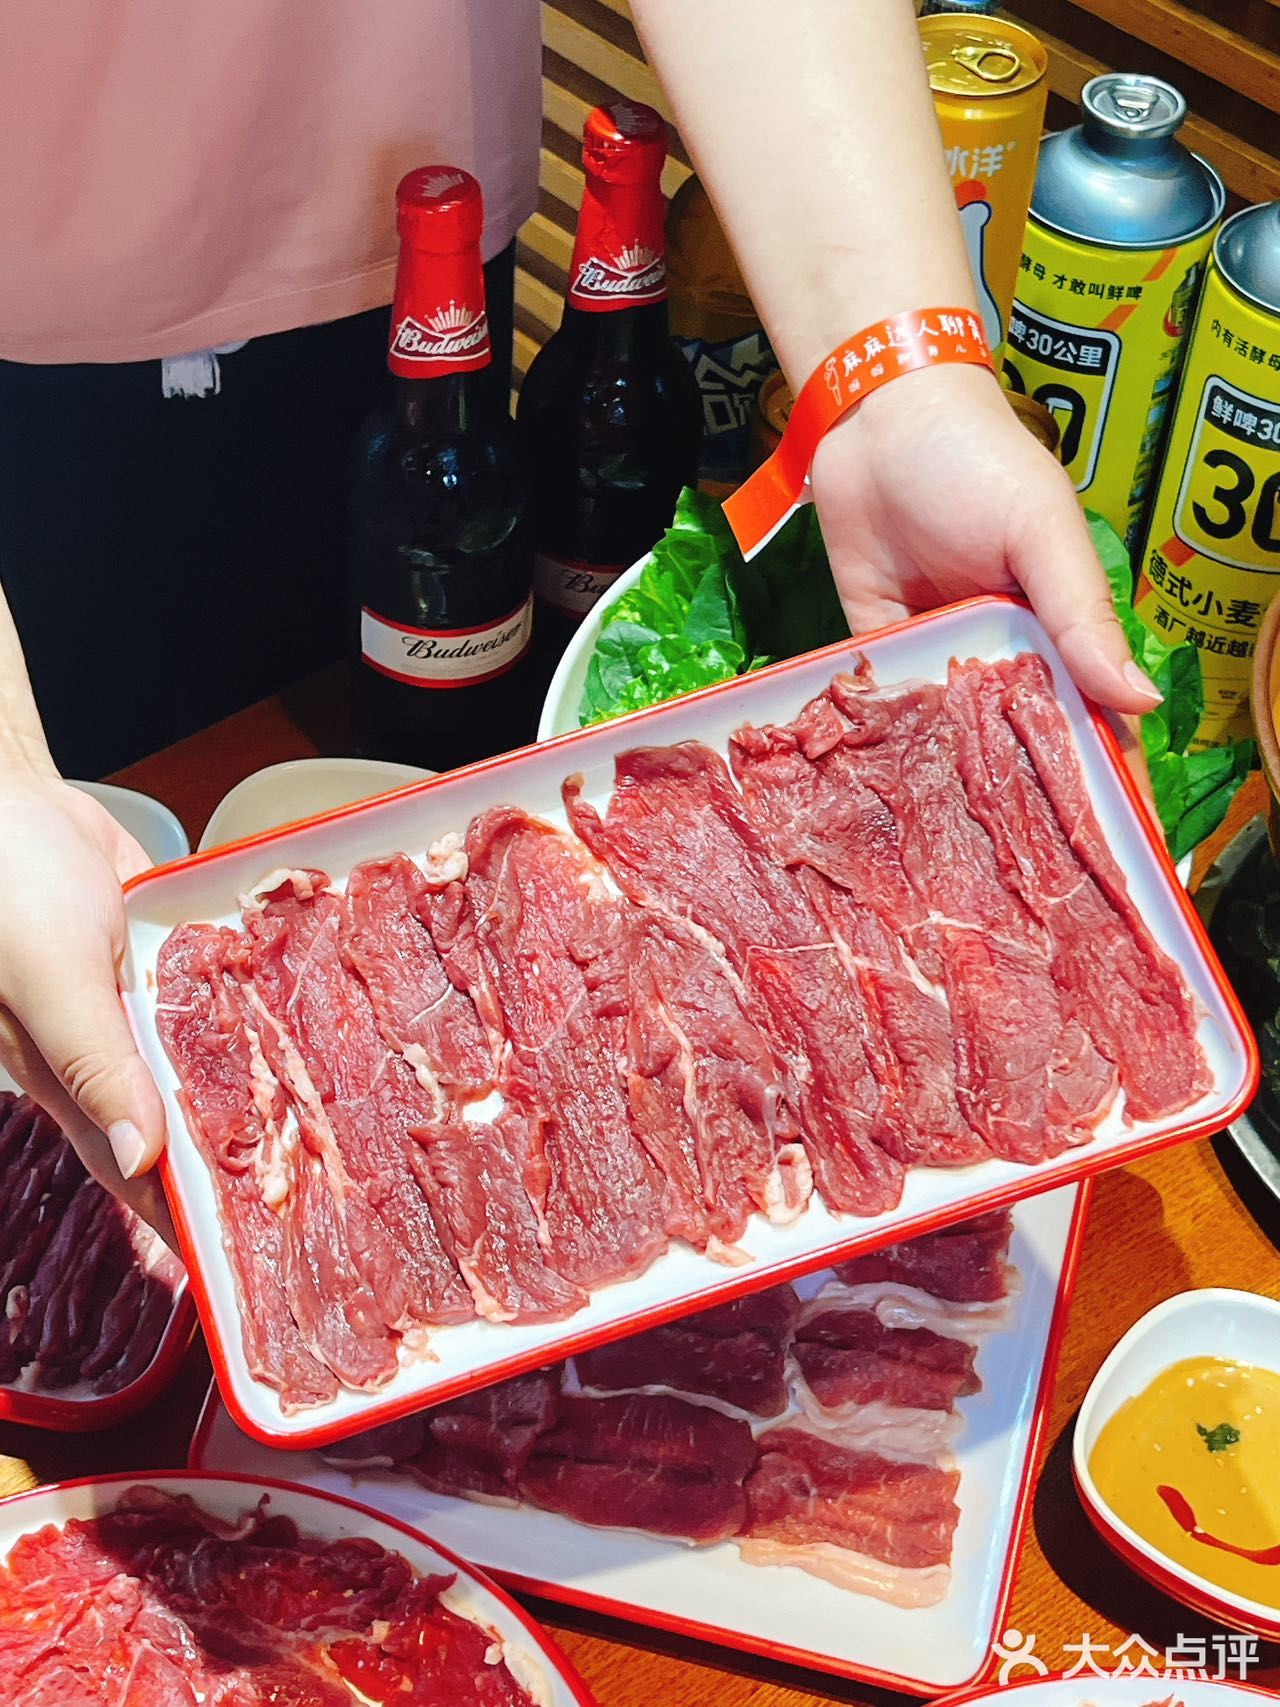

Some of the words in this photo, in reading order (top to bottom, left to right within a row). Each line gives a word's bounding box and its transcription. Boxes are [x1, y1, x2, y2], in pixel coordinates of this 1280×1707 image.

[1052, 273, 1143, 301] 才敢叫鲜啤
[1210, 318, 1280, 372] 内有活酵母
[1149, 549, 1266, 628] 德式小麦
[401, 621, 522, 660] Budweiser
[1153, 604, 1255, 659] 酒厂越近越
